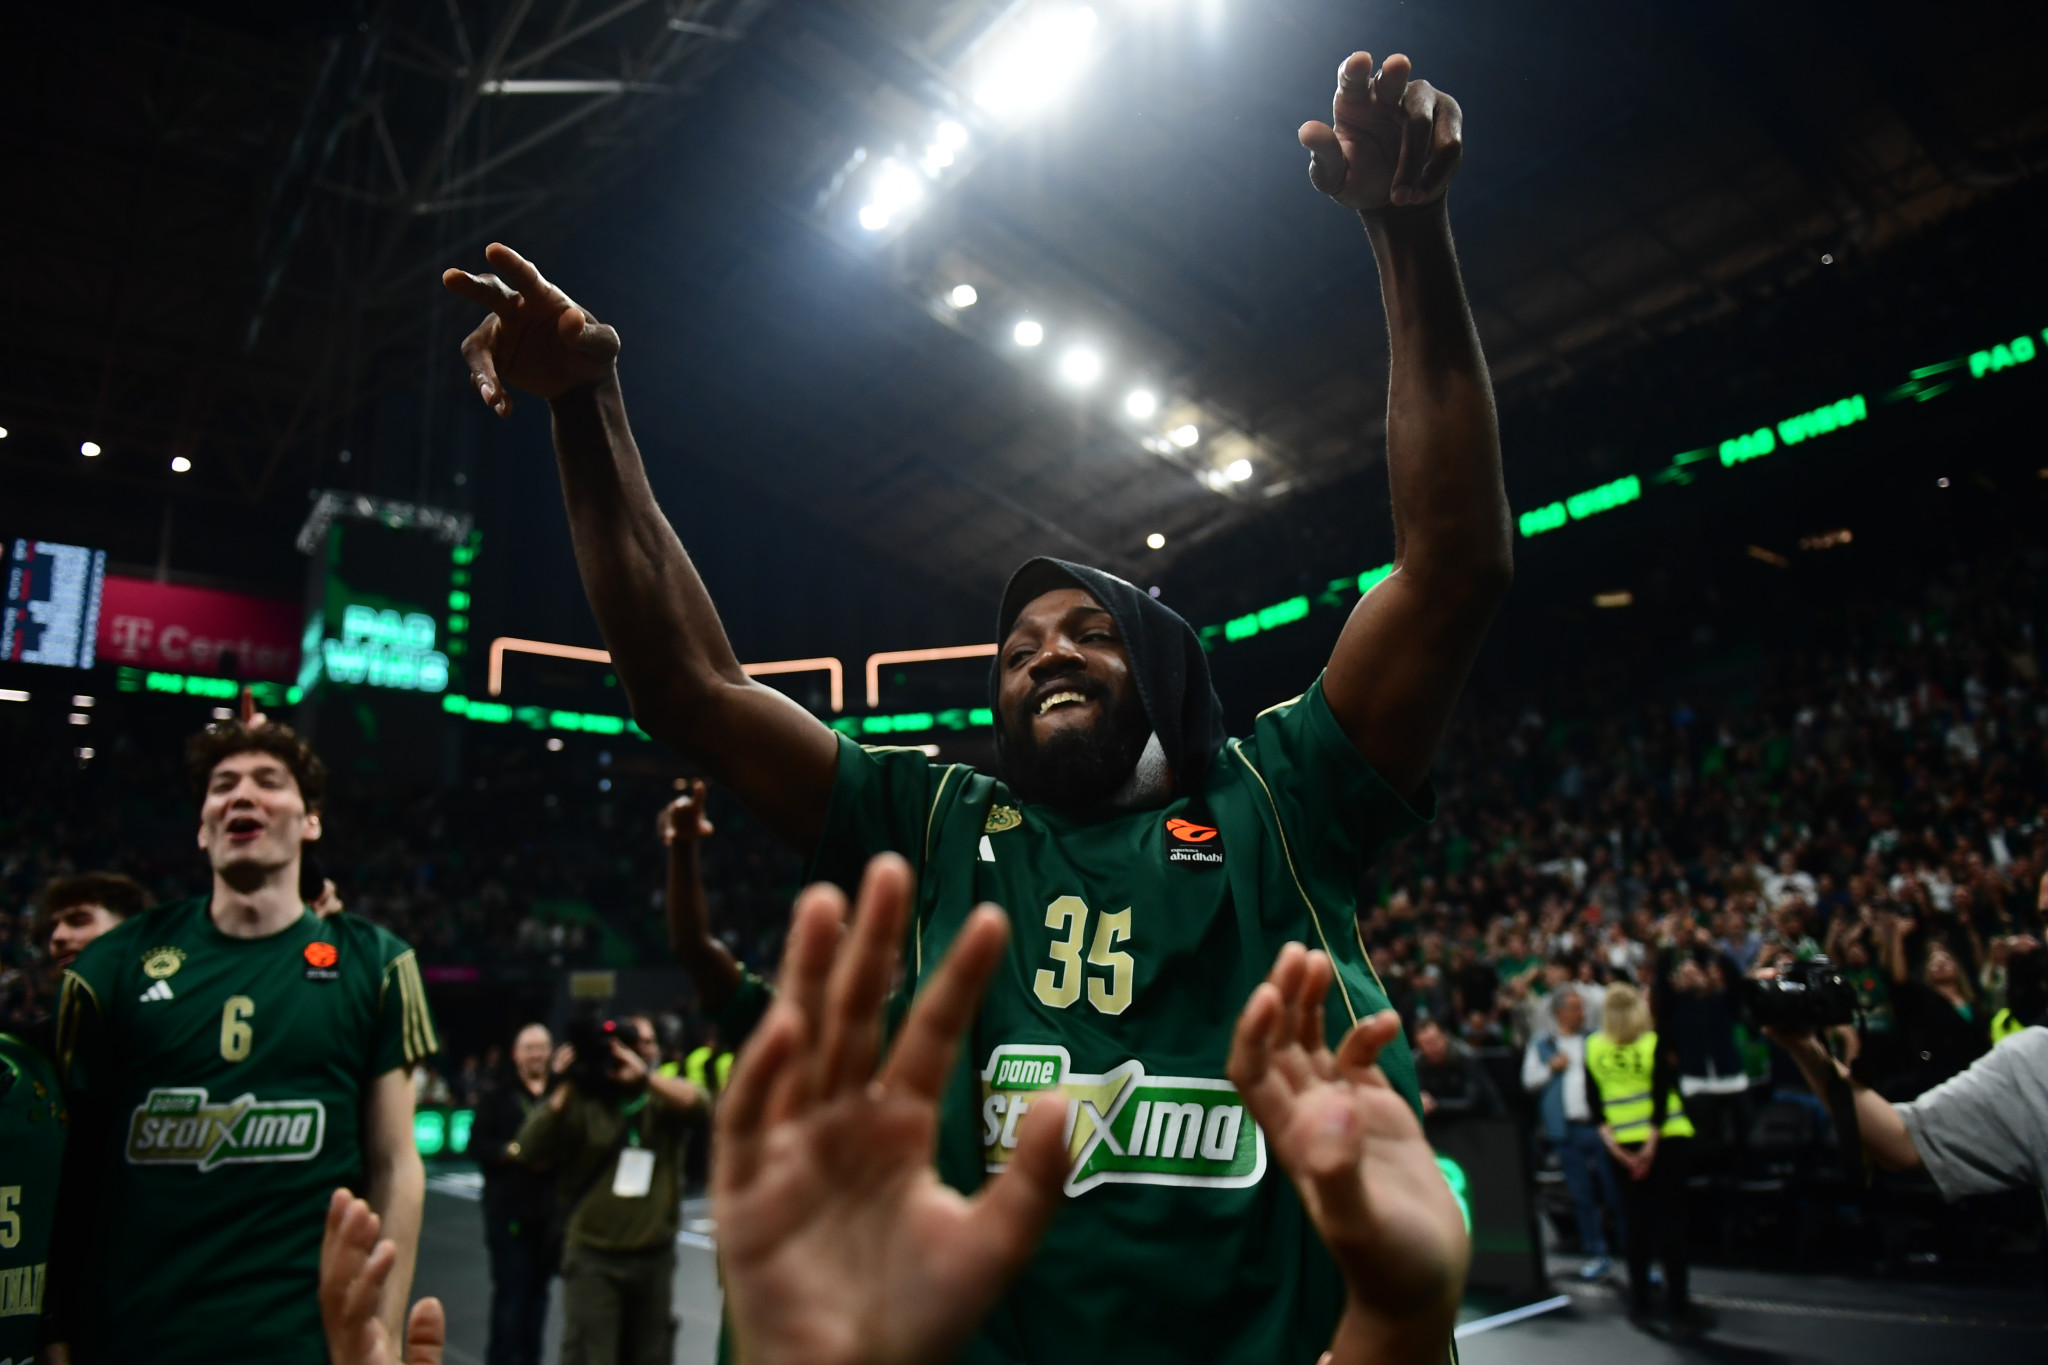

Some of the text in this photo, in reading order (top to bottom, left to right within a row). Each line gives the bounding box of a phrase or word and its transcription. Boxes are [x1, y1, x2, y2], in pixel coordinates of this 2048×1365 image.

[1170, 852, 1223, 863] abu dhabi
[1033, 895, 1135, 1016] 35
[219, 995, 255, 1063] 6
[996, 1058, 1055, 1085] pame
